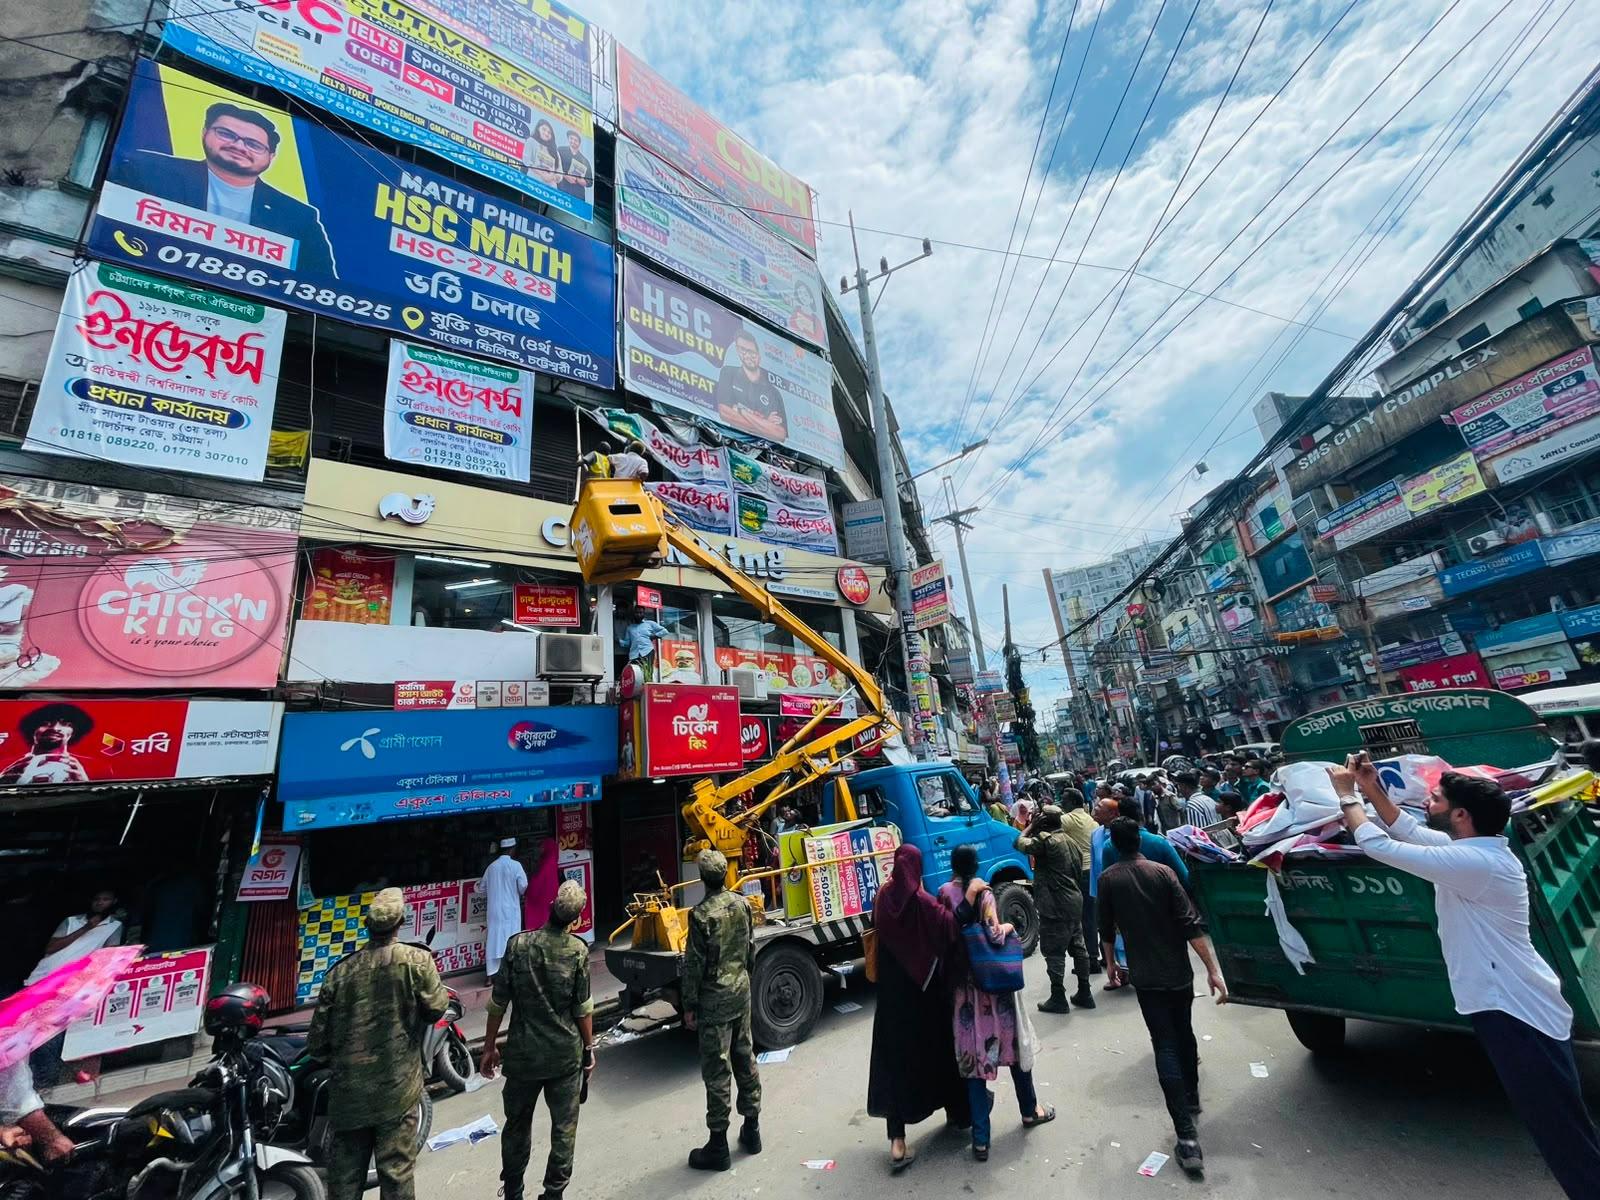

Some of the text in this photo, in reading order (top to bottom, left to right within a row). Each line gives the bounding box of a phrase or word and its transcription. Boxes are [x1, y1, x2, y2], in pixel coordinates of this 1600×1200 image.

[351, 19, 400, 54] IELTS
[368, 15, 429, 51] LANGUAGE
[432, 46, 482, 77] TRAINING
[195, 45, 232, 66] Mobile
[350, 41, 399, 74] TOEFL
[406, 70, 449, 97] SAT
[411, 50, 470, 88] Spoken
[473, 82, 527, 118] English
[511, 71, 584, 118] CARE
[322, 74, 482, 154] IELTS TOEFL SPOKEN ENGLISH GMAT GRE SAT
[463, 94, 487, 111] BBA
[461, 101, 486, 120] NSU
[499, 118, 524, 137] BRAC
[476, 131, 518, 155] Discount
[477, 123, 519, 147] Special
[400, 172, 555, 243] MATH PHILIC
[136, 197, 287, 262] রিমন স্যার
[374, 182, 573, 285] HSC MATH
[396, 233, 552, 297] HSC-27 & 28
[157, 245, 392, 321] 01886-138625
[404, 270, 542, 331] ভর্তি চলছে
[642, 281, 713, 339] HSC
[172, 308, 192, 322] সাল
[195, 314, 221, 328] থেকে
[430, 310, 470, 332] মুক্তি
[475, 323, 516, 346] ভবন
[630, 306, 725, 362] CHEMISTRY
[574, 367, 599, 383] রোড
[630, 348, 716, 394] DR.ARAFAT
[87, 383, 230, 427] প্রধান কার্যালয়
[209, 388, 229, 402] ভর্তি
[1298, 442, 1331, 471] SMS
[1334, 414, 1377, 446] CITY
[1383, 347, 1498, 414] COMPLEX
[413, 413, 504, 444] প্রধান কার্যালয়
[60, 427, 249, 466] 01818 089220, 01778 307010
[424, 447, 507, 469] 01818 089220
[424, 455, 507, 477] 01778 307010
[15, 529, 42, 541] LINE
[97, 589, 268, 621] CHICK'N
[124, 614, 236, 638] KING
[1568, 618, 1588, 628] JR
[130, 636, 221, 649] it's your choice
[1410, 679, 1437, 691] Bake
[1453, 670, 1477, 686] Fast
[1297, 711, 1347, 738] চট্টগ্রাম
[1348, 700, 1385, 721] সিটি
[130, 731, 171, 756] রবি
[378, 734, 443, 750] গ্রামীণফোন
[688, 736, 708, 750] কিং
[396, 776, 424, 790] একুশে
[425, 774, 458, 787] টেলিকম
[394, 790, 513, 811] একুশে টেলিকম
[251, 869, 288, 882] নগদ
[816, 839, 833, 918] 0192-502450
[1350, 874, 1404, 897] ১১০
